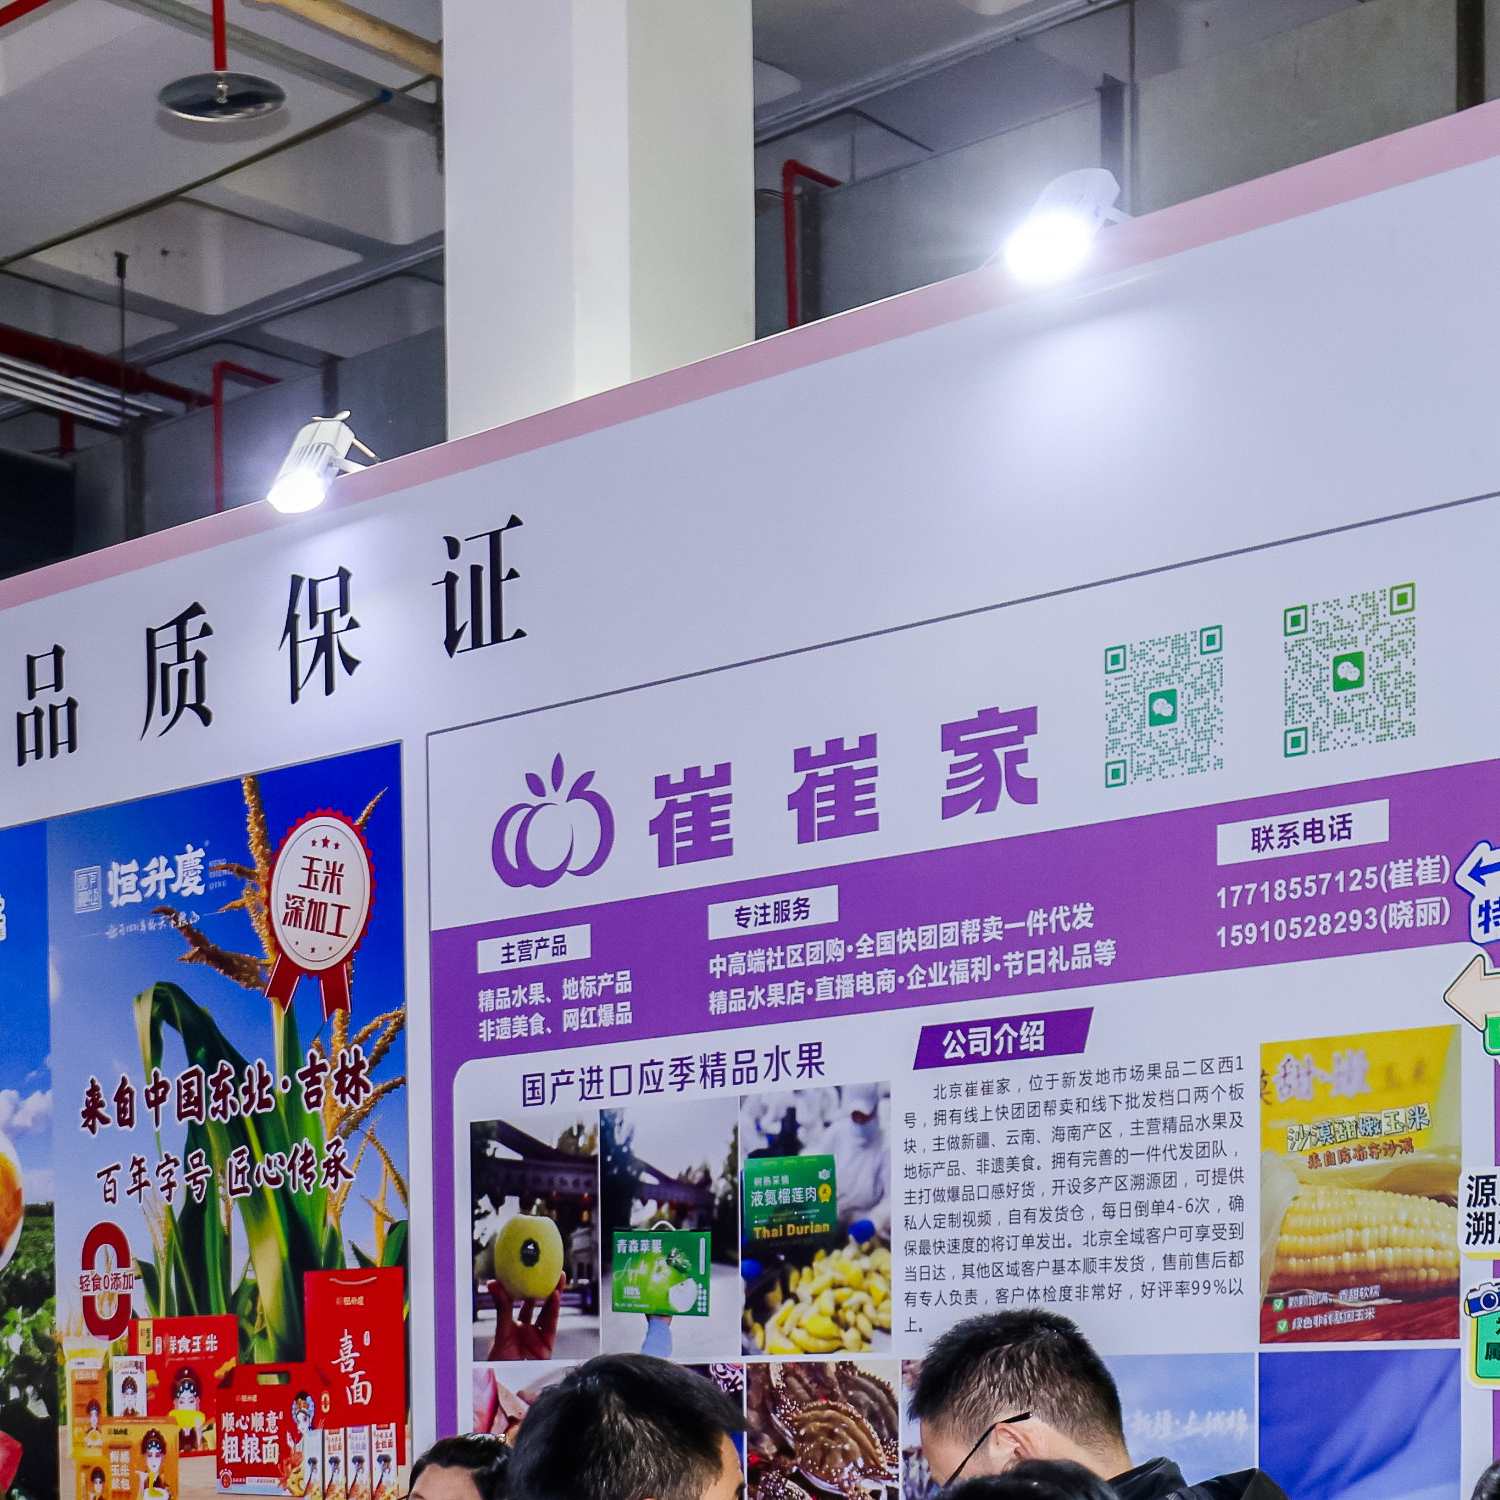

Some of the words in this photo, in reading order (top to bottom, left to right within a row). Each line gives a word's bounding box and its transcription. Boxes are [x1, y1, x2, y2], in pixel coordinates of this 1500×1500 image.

[648, 705, 1039, 868] 崔崔家
[1251, 812, 1354, 854] 联系电话
[299, 855, 344, 895] 玉米
[1215, 853, 1452, 912] 17718557125(崔崔)
[282, 893, 352, 939] 深加工
[733, 895, 811, 931] 专注服务
[1215, 894, 1452, 952] 15910528293(晓丽)
[500, 934, 568, 965] 主营产品
[707, 903, 1095, 981] 中高端社区团购·全国快团团帮卖一件代发
[477, 969, 633, 1014] 精品水果、地标产品
[707, 937, 1118, 1017] 精品水果店·直播电商·企业福利·节日礼品等
[477, 1000, 633, 1044] 非遗美食、网红爆品
[942, 1019, 1045, 1060] 公司介绍
[80, 1044, 373, 1138] 来自中国东北·吉林
[521, 1041, 826, 1108] 国产进口应季精品水果
[933, 1056, 1244, 1100] 北京崔崔家，位于新发地市场果品二区西1
[903, 1082, 1245, 1130] 号，拥有线上快团团帮卖和线下批发档口两个板
[903, 1110, 1245, 1155] 块，主做新疆、云南、海南产区，主营精品水果及
[1287, 1106, 1433, 1152] 沙漠甜嫩玉米
[96, 1146, 213, 1206] 百年字号
[227, 1134, 355, 1198] 匠心传承
[903, 1139, 1239, 1180] 地标产品、非遗美食。拥有完善的一件代发团队，
[903, 1165, 1245, 1205] 主打做爆品口感好货，开设多产区溯源团，可提供
[753, 1224, 783, 1240] Thai
[786, 1221, 830, 1237] Durian
[903, 1194, 1245, 1232] 私人定制视频，自有发货仓，每日倒单4-6次，确
[903, 1221, 1245, 1257] 保最快速度的将订单发出。北京全域客户可享受到
[79, 1271, 134, 1293] 轻食0添加
[903, 1249, 1245, 1283] 当日达，其他区域客户基本顺丰发货，售前售后都
[905, 1314, 924, 1331] 上。
[220, 1409, 280, 1434] 顺心顺意
[220, 1432, 281, 1466] 粗粮面
